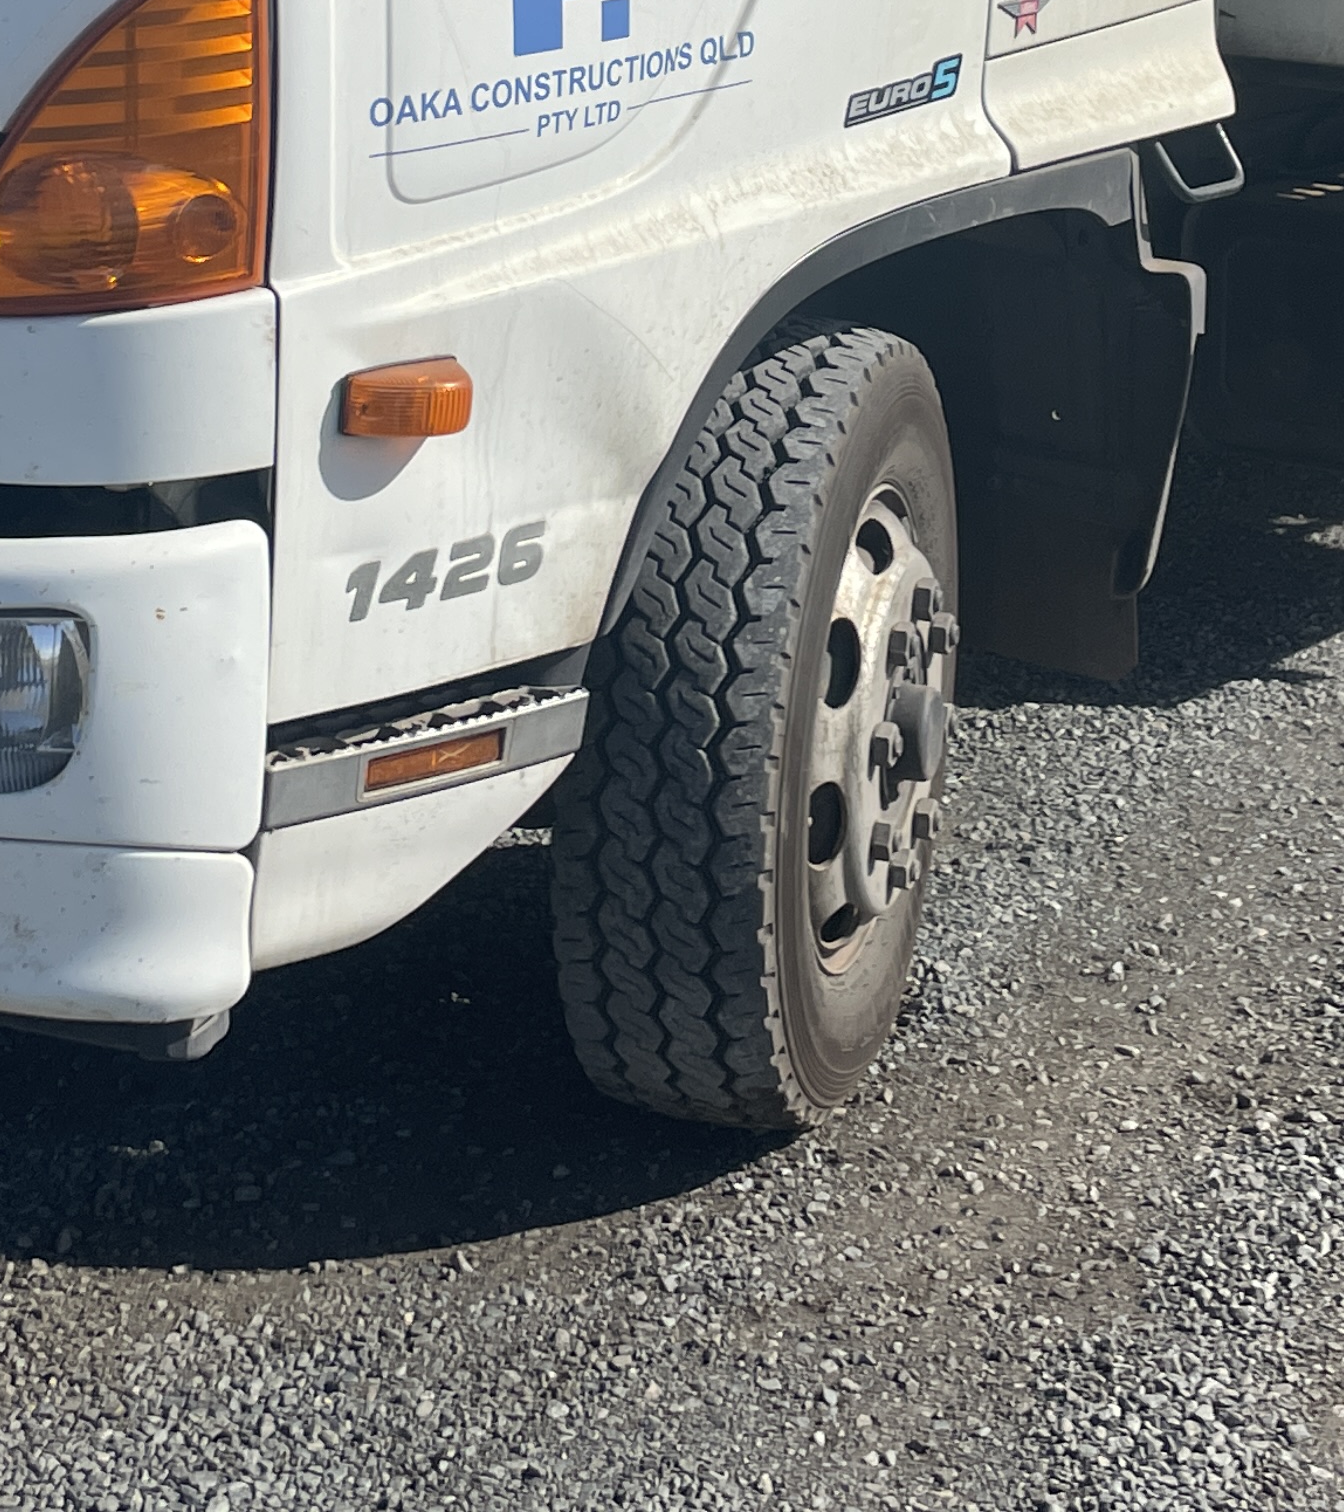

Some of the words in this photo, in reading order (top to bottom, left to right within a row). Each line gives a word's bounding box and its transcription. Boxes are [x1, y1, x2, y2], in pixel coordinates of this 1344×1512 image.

[369, 88, 463, 128] OAKA
[470, 43, 692, 113] CONSTRUCTIONS
[700, 31, 755, 66] QLD
[537, 107, 579, 137] PTY
[583, 100, 621, 128] LTD
[345, 521, 547, 623] 1426
